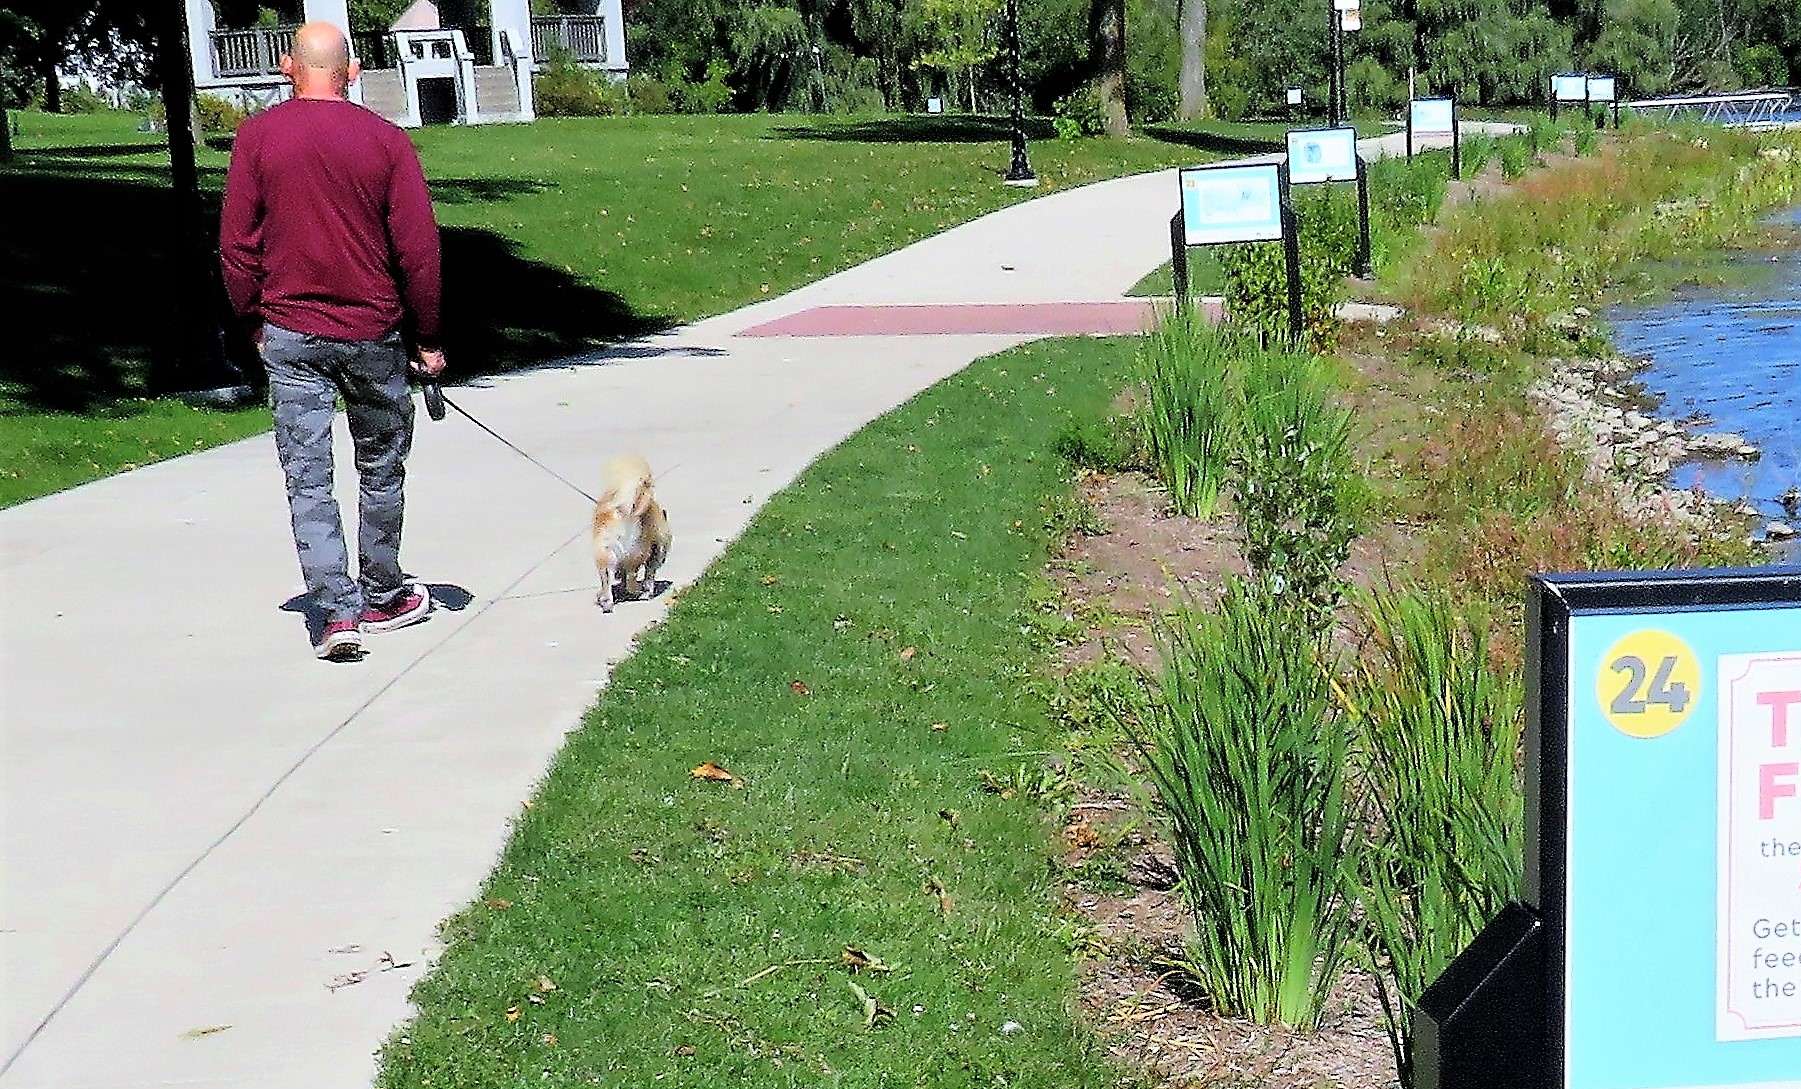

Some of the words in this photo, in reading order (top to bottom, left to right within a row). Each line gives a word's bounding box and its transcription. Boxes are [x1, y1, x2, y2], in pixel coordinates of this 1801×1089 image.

[1610, 655, 1690, 714] 24
[1760, 837, 1801, 857] the
[1752, 917, 1801, 940] Get
[1752, 975, 1797, 1000] the
